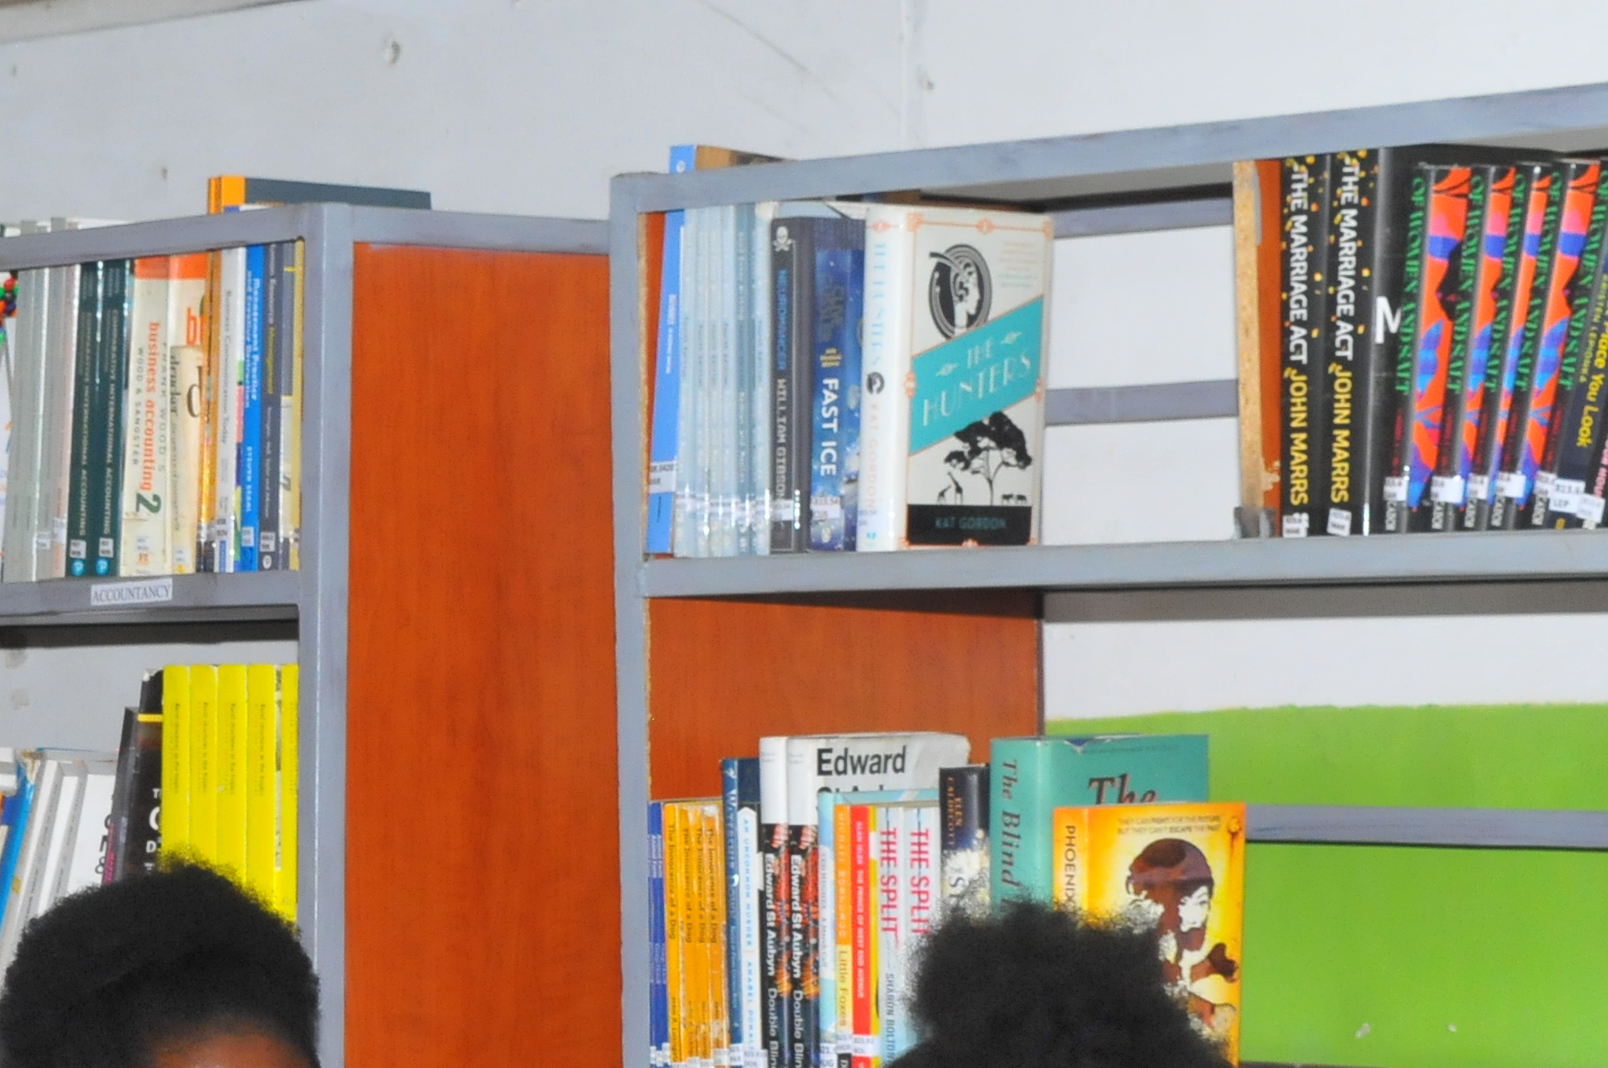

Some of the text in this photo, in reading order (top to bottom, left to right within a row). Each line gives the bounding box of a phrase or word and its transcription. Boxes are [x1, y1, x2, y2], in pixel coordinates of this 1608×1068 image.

[1411, 176, 1426, 206] OF
[1469, 176, 1484, 205] OF
[1404, 211, 1425, 292] WOMEN
[1462, 210, 1482, 292] WOMEN
[267, 278, 279, 325] Resource
[249, 277, 262, 401] Management Practice
[967, 338, 993, 369] THE
[1288, 173, 1310, 507] THE MARRIAGE ACT JOHN MARRS
[1330, 165, 1360, 504] THE MARRIAGE ACT JOHN MARRS
[135, 347, 144, 383] WOOD
[265, 327, 277, 394] Management
[776, 378, 789, 444] WILLIAM
[820, 377, 840, 434] FAST
[923, 351, 1032, 427] HUNTERS
[1577, 373, 1606, 447] You Look
[102, 309, 120, 536] COMPARATIVE INTERNATIONAL ACCOUNTING
[131, 401, 142, 467] SANGSTER
[135, 322, 163, 515] business accounting 2
[221, 415, 230, 444] Today
[776, 446, 789, 502] GIBSON
[818, 442, 838, 478] ICE
[959, 516, 1007, 530] GORDON
[92, 584, 172, 604] ACCOUNTANCY
[815, 746, 907, 777] Edward
[1088, 772, 1160, 804] The
[837, 813, 846, 863] MICHAEL
[855, 821, 864, 842] ALAN
[1001, 759, 1024, 889] The Blind
[668, 844, 676, 895] Innocence
[743, 818, 753, 947] AN UNCOMMON MURDER
[765, 853, 777, 910] Edward
[791, 854, 804, 911] Edward
[855, 868, 865, 885] THE
[878, 827, 899, 936] THE SPLIT
[909, 828, 932, 937] THE SPLIT
[1063, 824, 1078, 903] PHOENIX
[669, 897, 677, 908] of
[766, 911, 777, 928] St
[792, 912, 804, 930] St
[855, 886, 865, 913] PRINCE
[856, 914, 865, 926] OF
[668, 919, 677, 940] Dog
[764, 929, 778, 977] Aubyn
[790, 931, 805, 978] Aubyn
[856, 926, 865, 949] WEST
[856, 949, 865, 966] END
[837, 950, 849, 1027] Little Foxes
[856, 968, 865, 998] AVENUE
[746, 1009, 755, 1050] DONAL
[767, 987, 779, 1037] Double
[792, 989, 804, 1039] Double
[884, 973, 897, 1062] SHARON BOLTON
